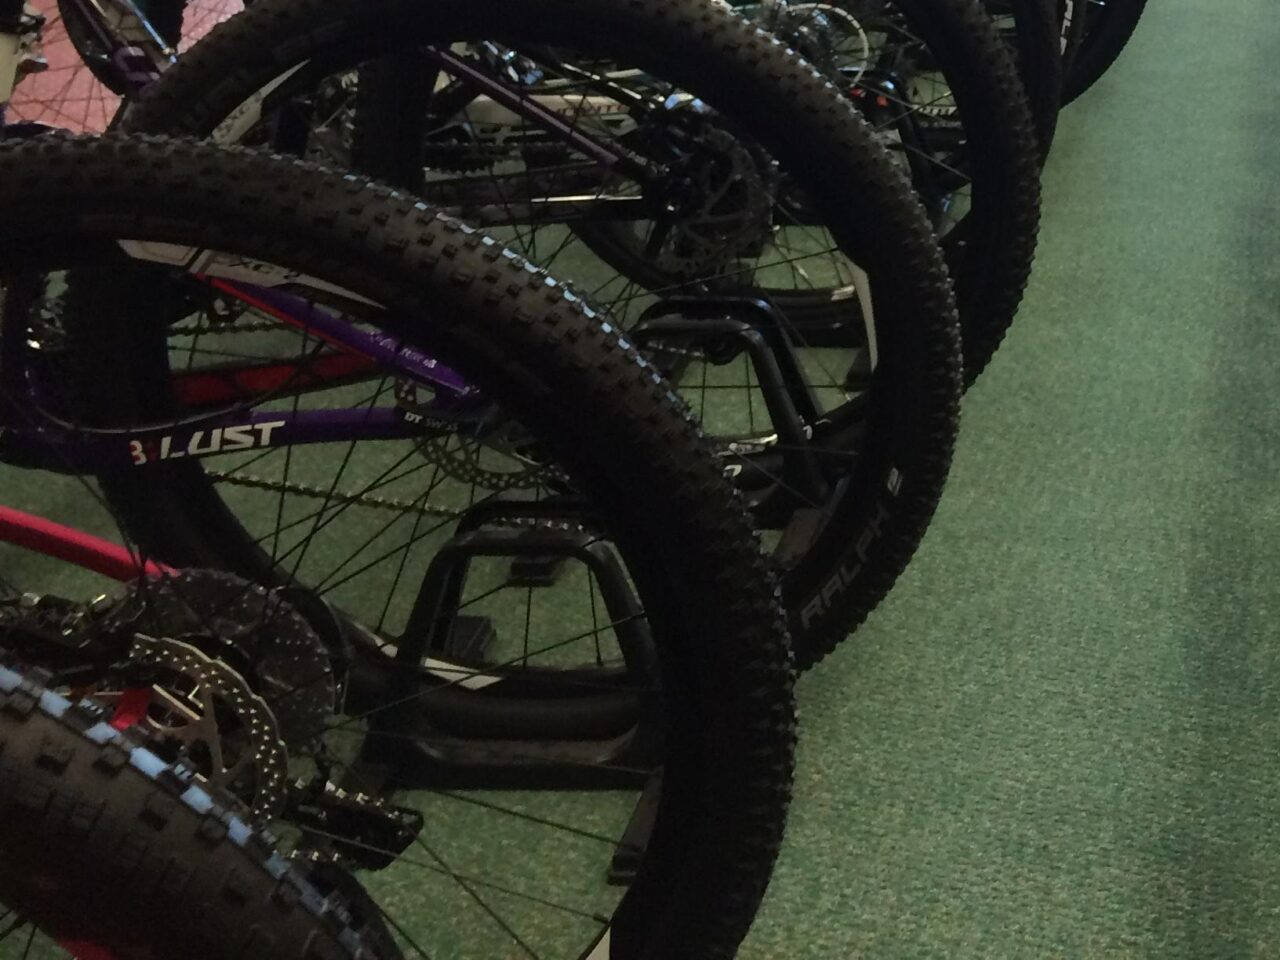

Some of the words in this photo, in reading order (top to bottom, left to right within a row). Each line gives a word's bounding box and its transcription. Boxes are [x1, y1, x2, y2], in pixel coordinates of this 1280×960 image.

[404, 411, 424, 424] DT
[160, 420, 286, 460] LUST
[801, 500, 890, 630] RALPH
